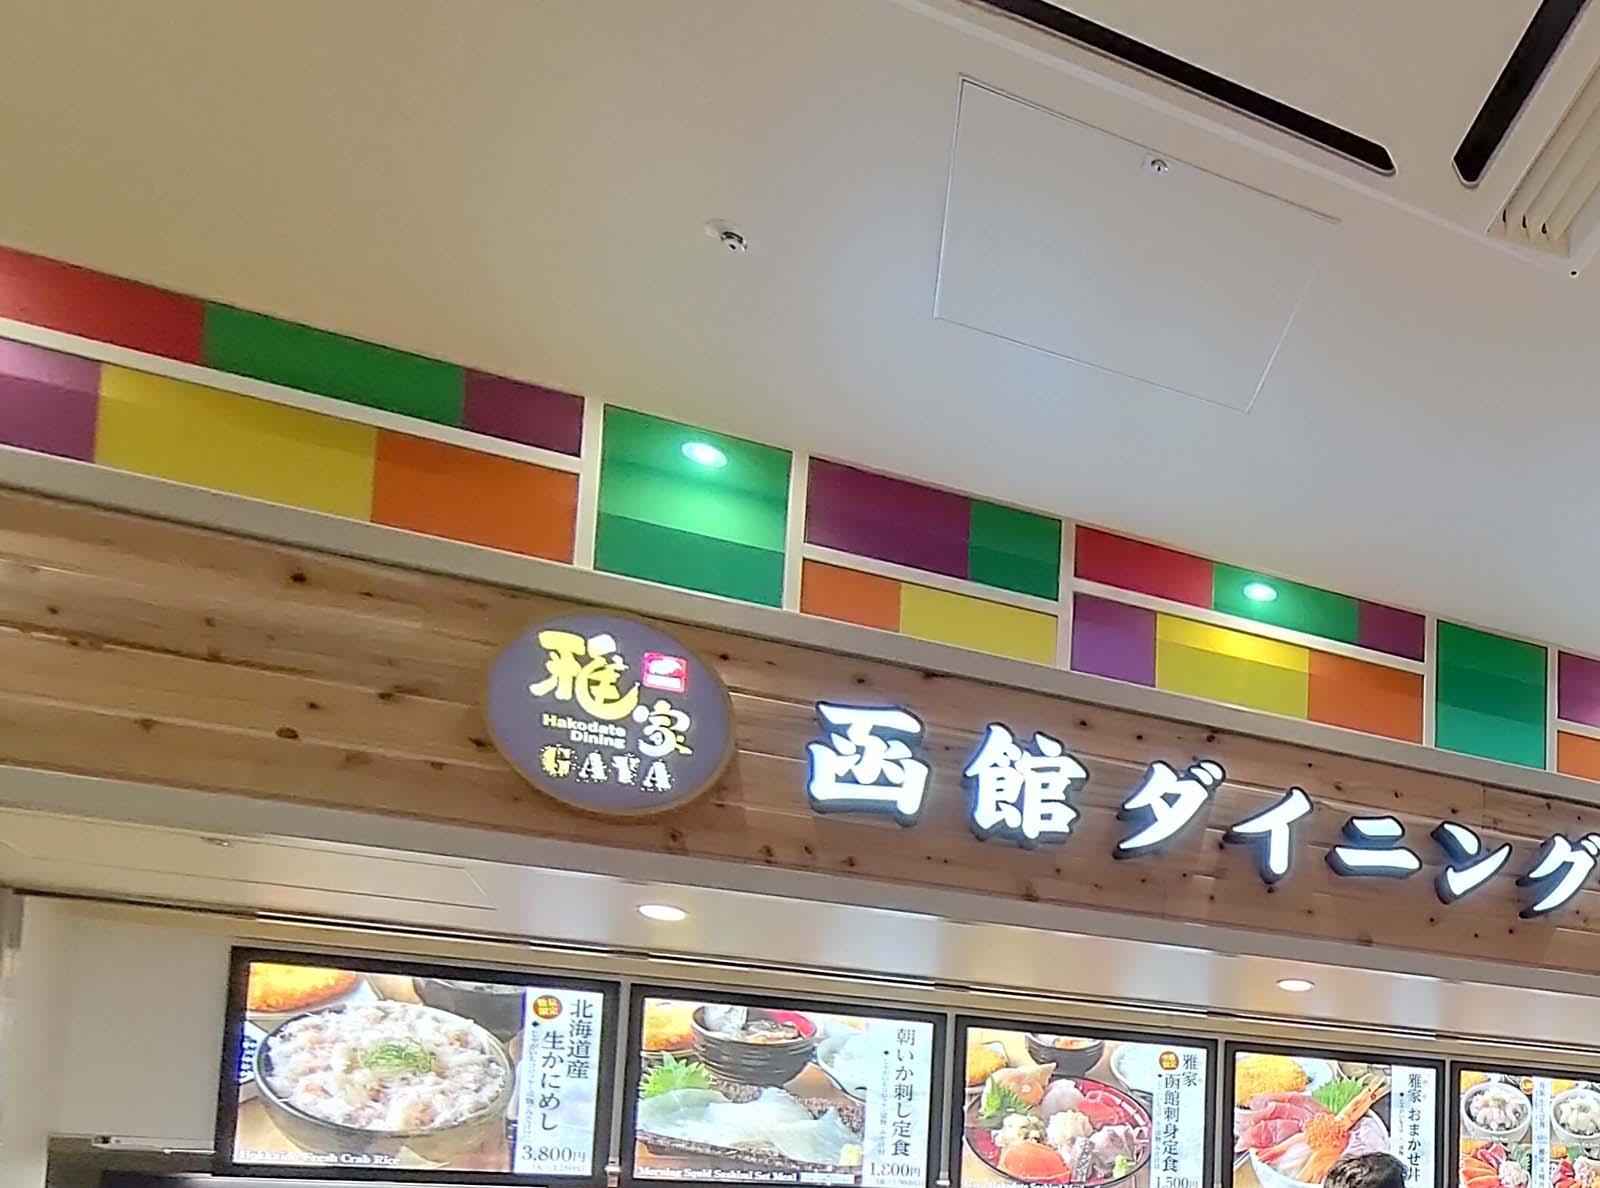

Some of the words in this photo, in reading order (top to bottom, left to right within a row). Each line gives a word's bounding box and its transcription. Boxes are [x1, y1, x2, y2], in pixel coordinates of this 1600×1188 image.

[543, 713, 627, 738] Hakodate
[569, 730, 627, 749] Dining
[541, 745, 675, 791] GAYA
[566, 999, 593, 1079] 北海道産
[539, 1031, 565, 1130] 生かにめし
[1182, 1054, 1199, 1087] 雅家
[1408, 1073, 1422, 1103] 雅家
[891, 1028, 916, 1157] 朝いか刺し定食
[1162, 1074, 1181, 1173] 函館刺身定食
[304, 1152, 338, 1163] Fresh
[340, 1153, 371, 1164] Crab
[374, 1155, 400, 1166] Rice
[1407, 1107, 1422, 1183] おまかせ丼
[638, 1166, 682, 1178] Morning
[684, 1168, 712, 1179] Squid
[755, 1171, 772, 1180] Set
